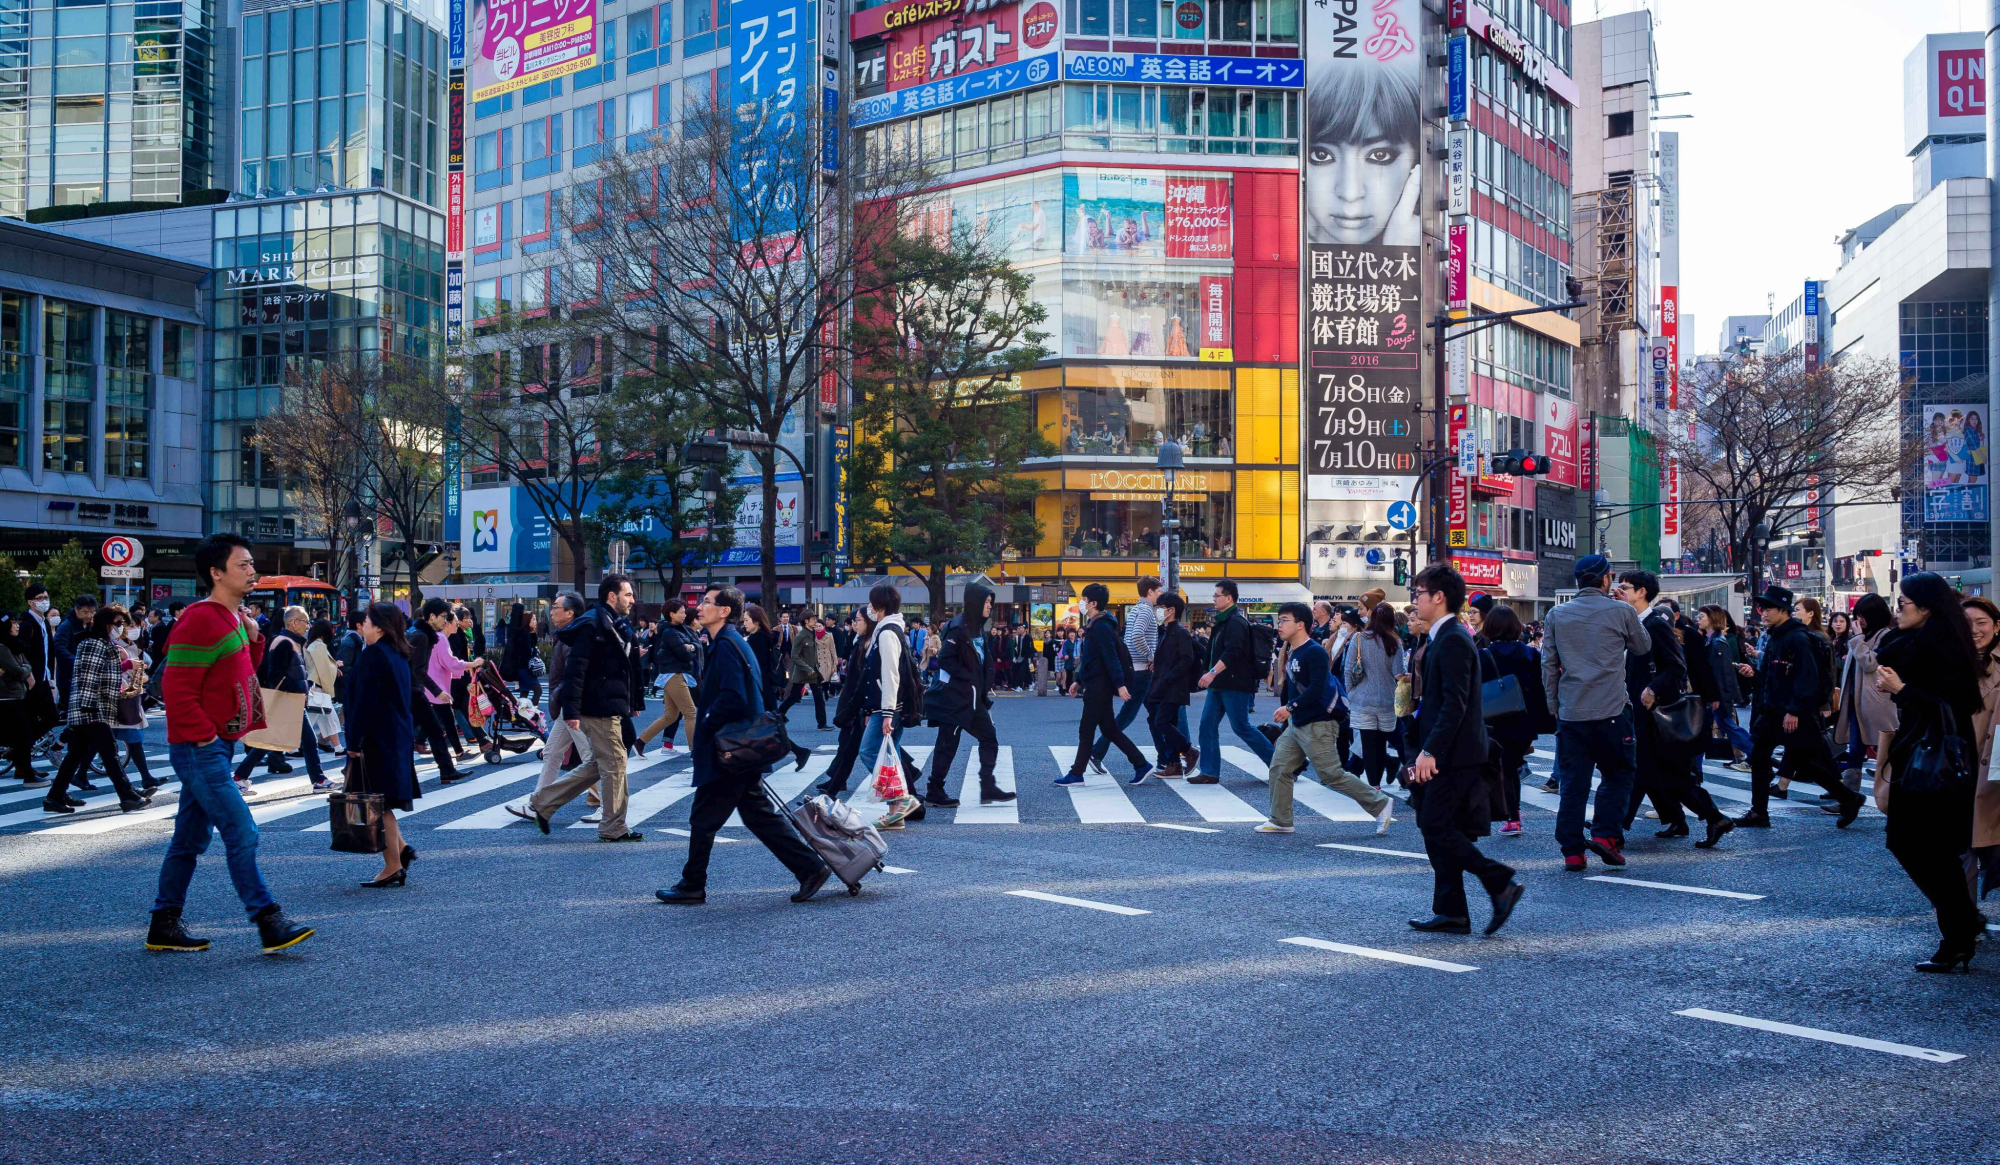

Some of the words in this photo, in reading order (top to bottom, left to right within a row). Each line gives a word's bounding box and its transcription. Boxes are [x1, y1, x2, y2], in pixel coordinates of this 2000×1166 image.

[452, 0, 462, 55] 急リバブル
[1027, 21, 1054, 38] ガスト
[1366, 0, 1413, 60] み
[496, 45, 517, 61] 当ビル
[893, 45, 926, 69] Café
[930, 23, 1010, 79] ガスト
[500, 62, 513, 76] 4F
[550, 58, 592, 76] 0120-326-500
[857, 56, 885, 85] 7F
[893, 65, 926, 82] レストラン
[1074, 58, 1125, 75] AEON
[1141, 57, 1299, 82] 英会話イーオン
[1523, 44, 1549, 87] ガスト
[1947, 57, 1985, 80] UN
[903, 68, 1020, 113] 英会話イーオン
[1029, 62, 1047, 79] 6F
[1453, 45, 1463, 113] 英会話イーオン
[1947, 85, 1985, 112] QL
[450, 154, 463, 163] 8F
[1453, 138, 1463, 208] 渋谷駅前ビル
[451, 173, 462, 216] 外貨両替
[1167, 185, 1206, 203] 沖縄
[1167, 206, 1228, 214] フォトウェディング
[1450, 226, 1466, 235] 5F
[262, 248, 330, 263] SHIBUYA
[1311, 251, 1418, 281] 国立代々木
[227, 265, 298, 285] MARK
[311, 259, 370, 277] CITY
[264, 295, 281, 306] 渋谷
[284, 292, 326, 304] マークシティ
[1311, 283, 1419, 314] 競技場第一
[1208, 283, 1223, 342] 毎日開催
[1664, 299, 1675, 324] 免税
[1311, 316, 1379, 346] 体育館
[1391, 314, 1408, 336] 3
[1386, 329, 1416, 350] Days!
[1208, 351, 1224, 360] 4F
[1350, 355, 1380, 366] 2016
[1318, 374, 1411, 404] 7月8日(金)
[1318, 407, 1411, 436] 7月9日(土)
[1313, 440, 1416, 470] 7月10日(日)
[1466, 432, 1475, 472] 渋谷駅前
[1551, 431, 1572, 458] アコム
[1557, 465, 1565, 480] 3F
[533, 541, 551, 549] SUMIT
[1545, 518, 1576, 549] LUSH
[104, 569, 131, 577] ここまで
